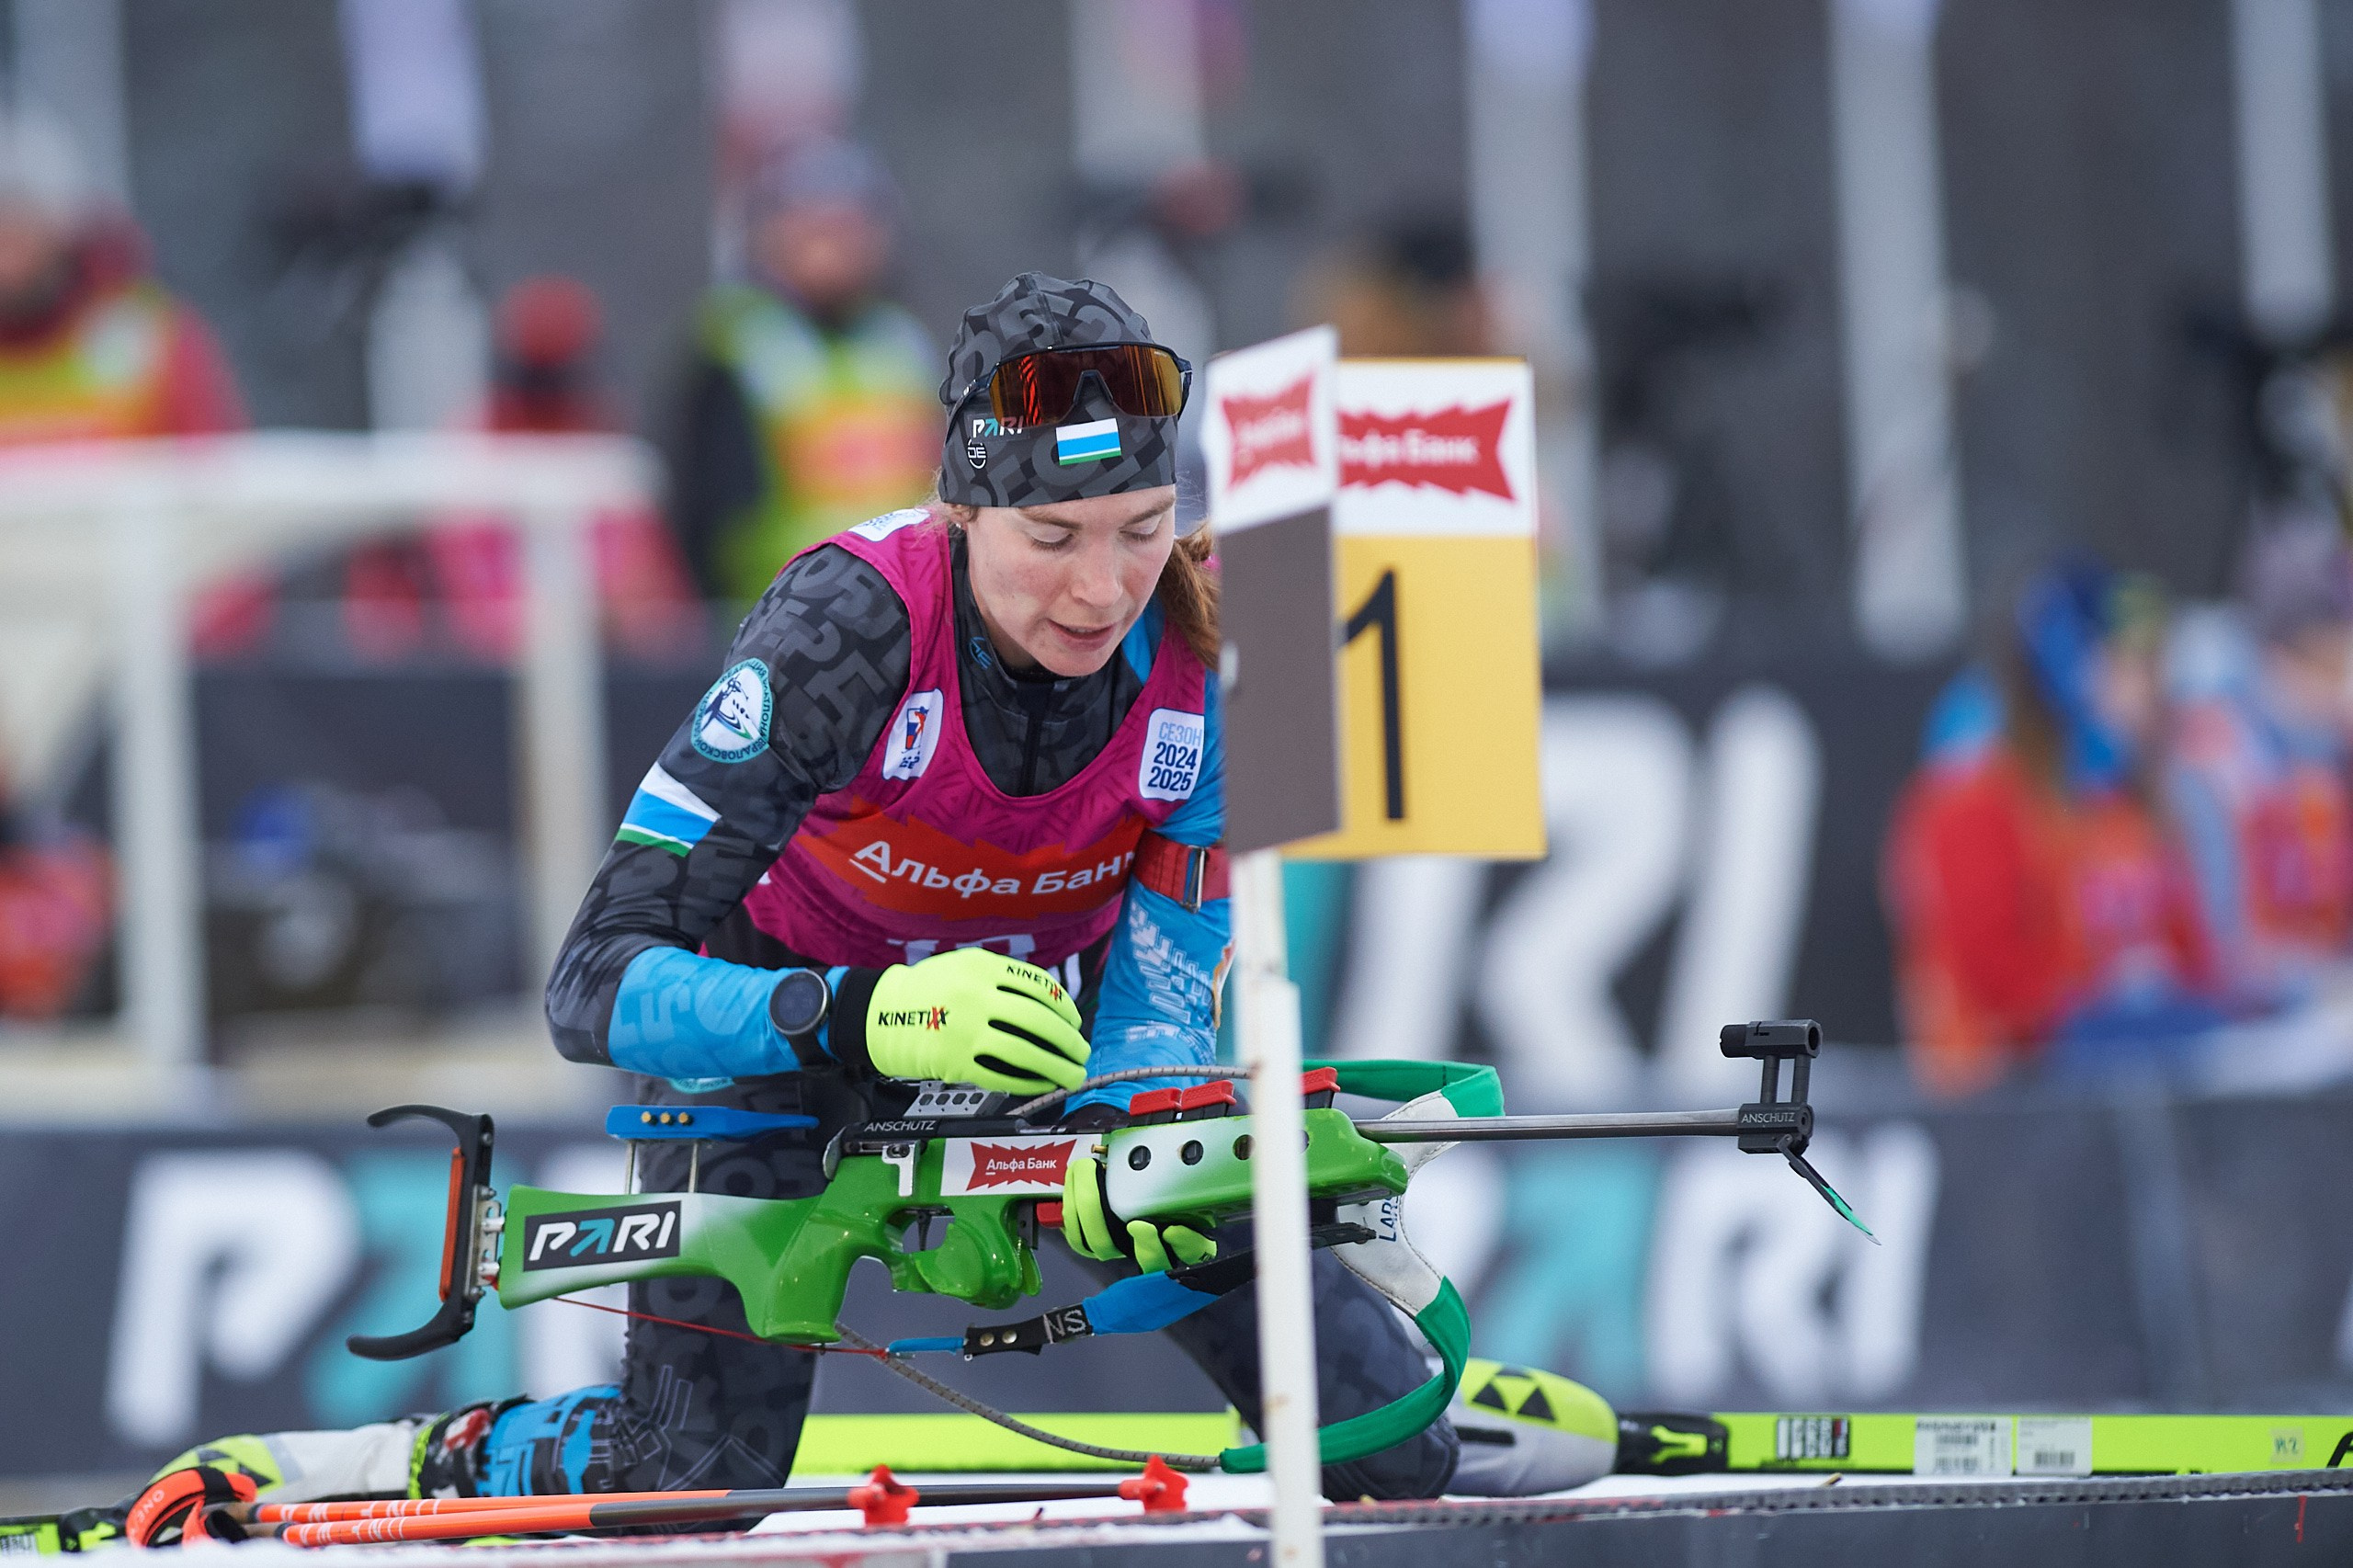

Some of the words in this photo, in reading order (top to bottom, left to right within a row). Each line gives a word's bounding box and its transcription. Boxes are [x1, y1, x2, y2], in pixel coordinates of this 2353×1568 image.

[972, 415, 1024, 438] PARI
[1337, 569, 1404, 820] 1
[1158, 722, 1203, 747] СЕЗОН
[1154, 741, 1199, 770] 2024
[1147, 766, 1194, 792] 2025
[849, 840, 1021, 898] Альфа
[985, 1158, 1026, 1175] Альфа
[1027, 1157, 1057, 1169] Банк
[529, 1210, 676, 1261] PARI
